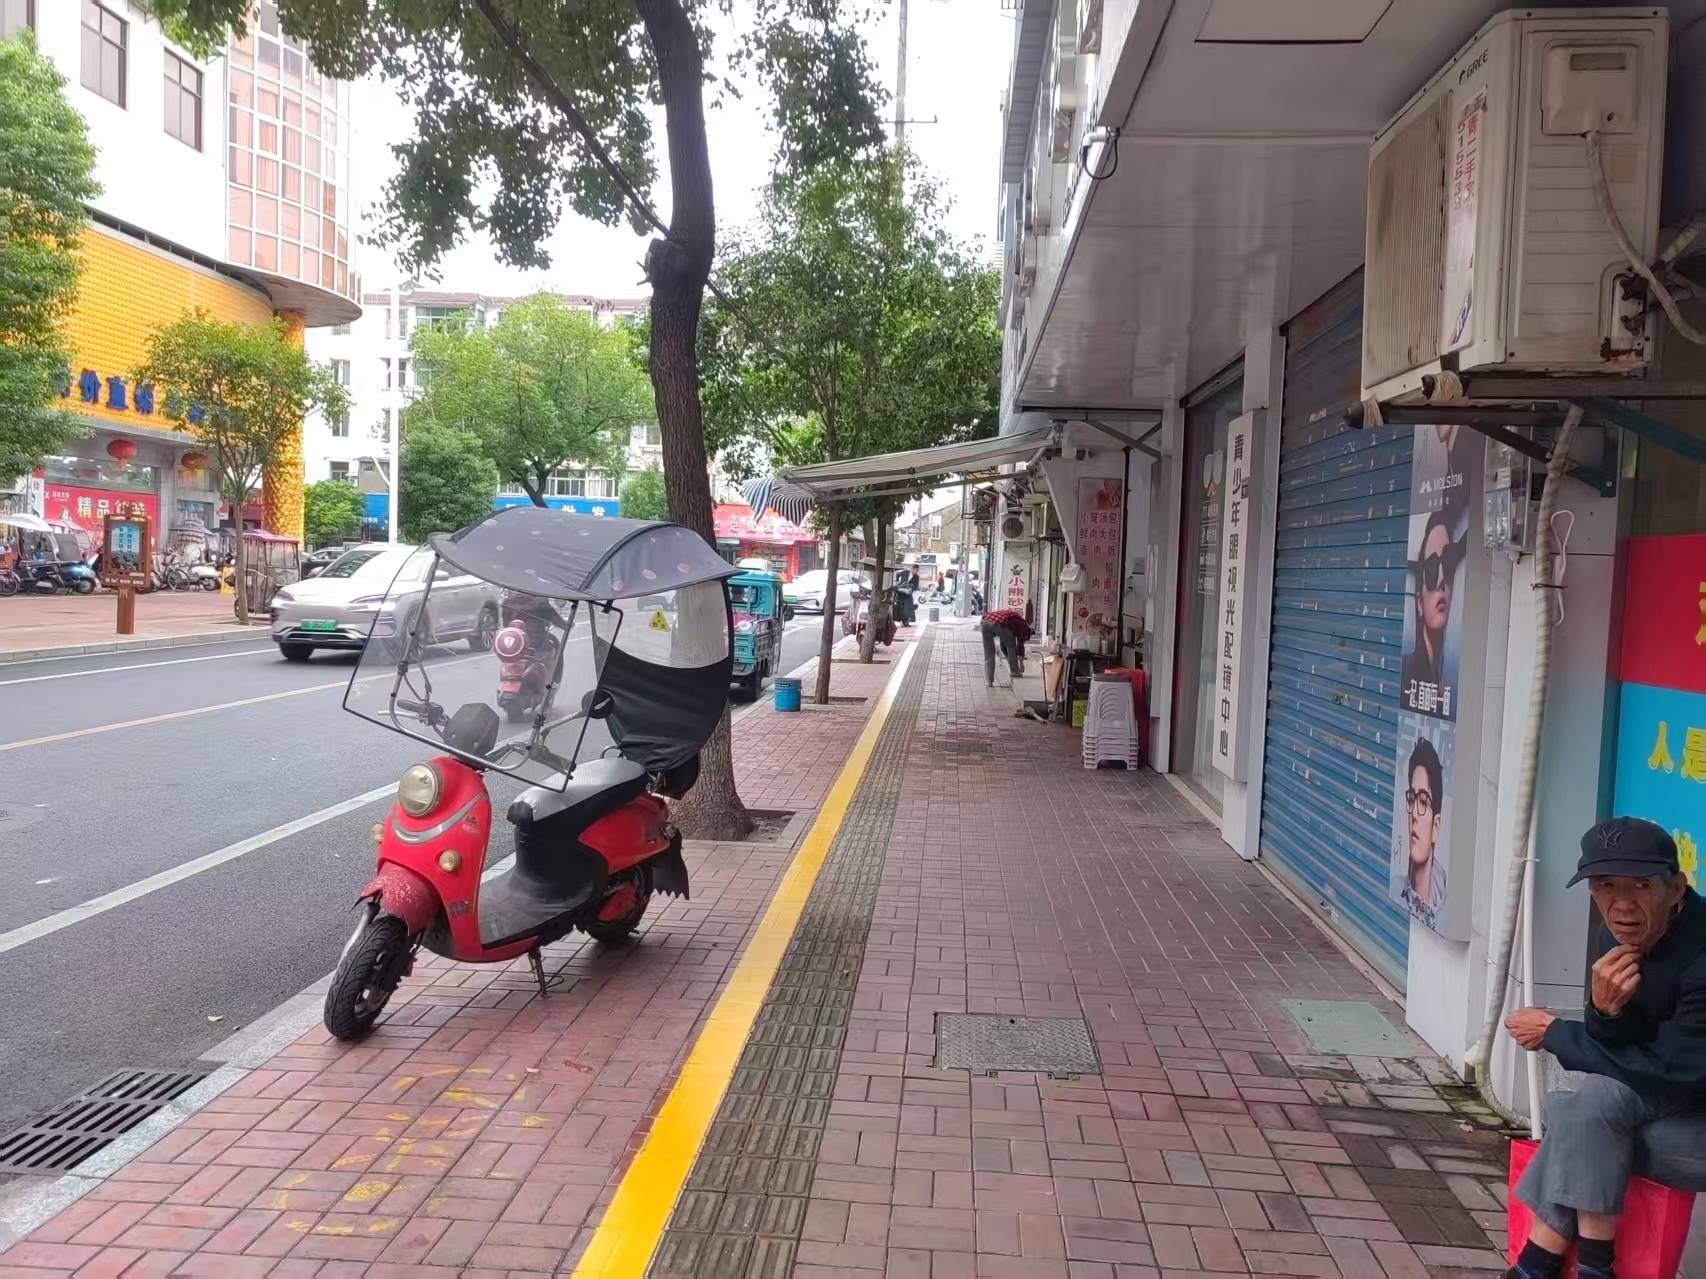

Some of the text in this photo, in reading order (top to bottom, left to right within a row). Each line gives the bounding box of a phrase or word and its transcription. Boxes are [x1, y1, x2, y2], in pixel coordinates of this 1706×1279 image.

[1466, 49, 1489, 79] GREE
[1080, 512, 1117, 524] 小笼汤包
[1080, 529, 1117, 541] 鲜肉大包
[1404, 678, 1452, 716] 一起直面每一面
